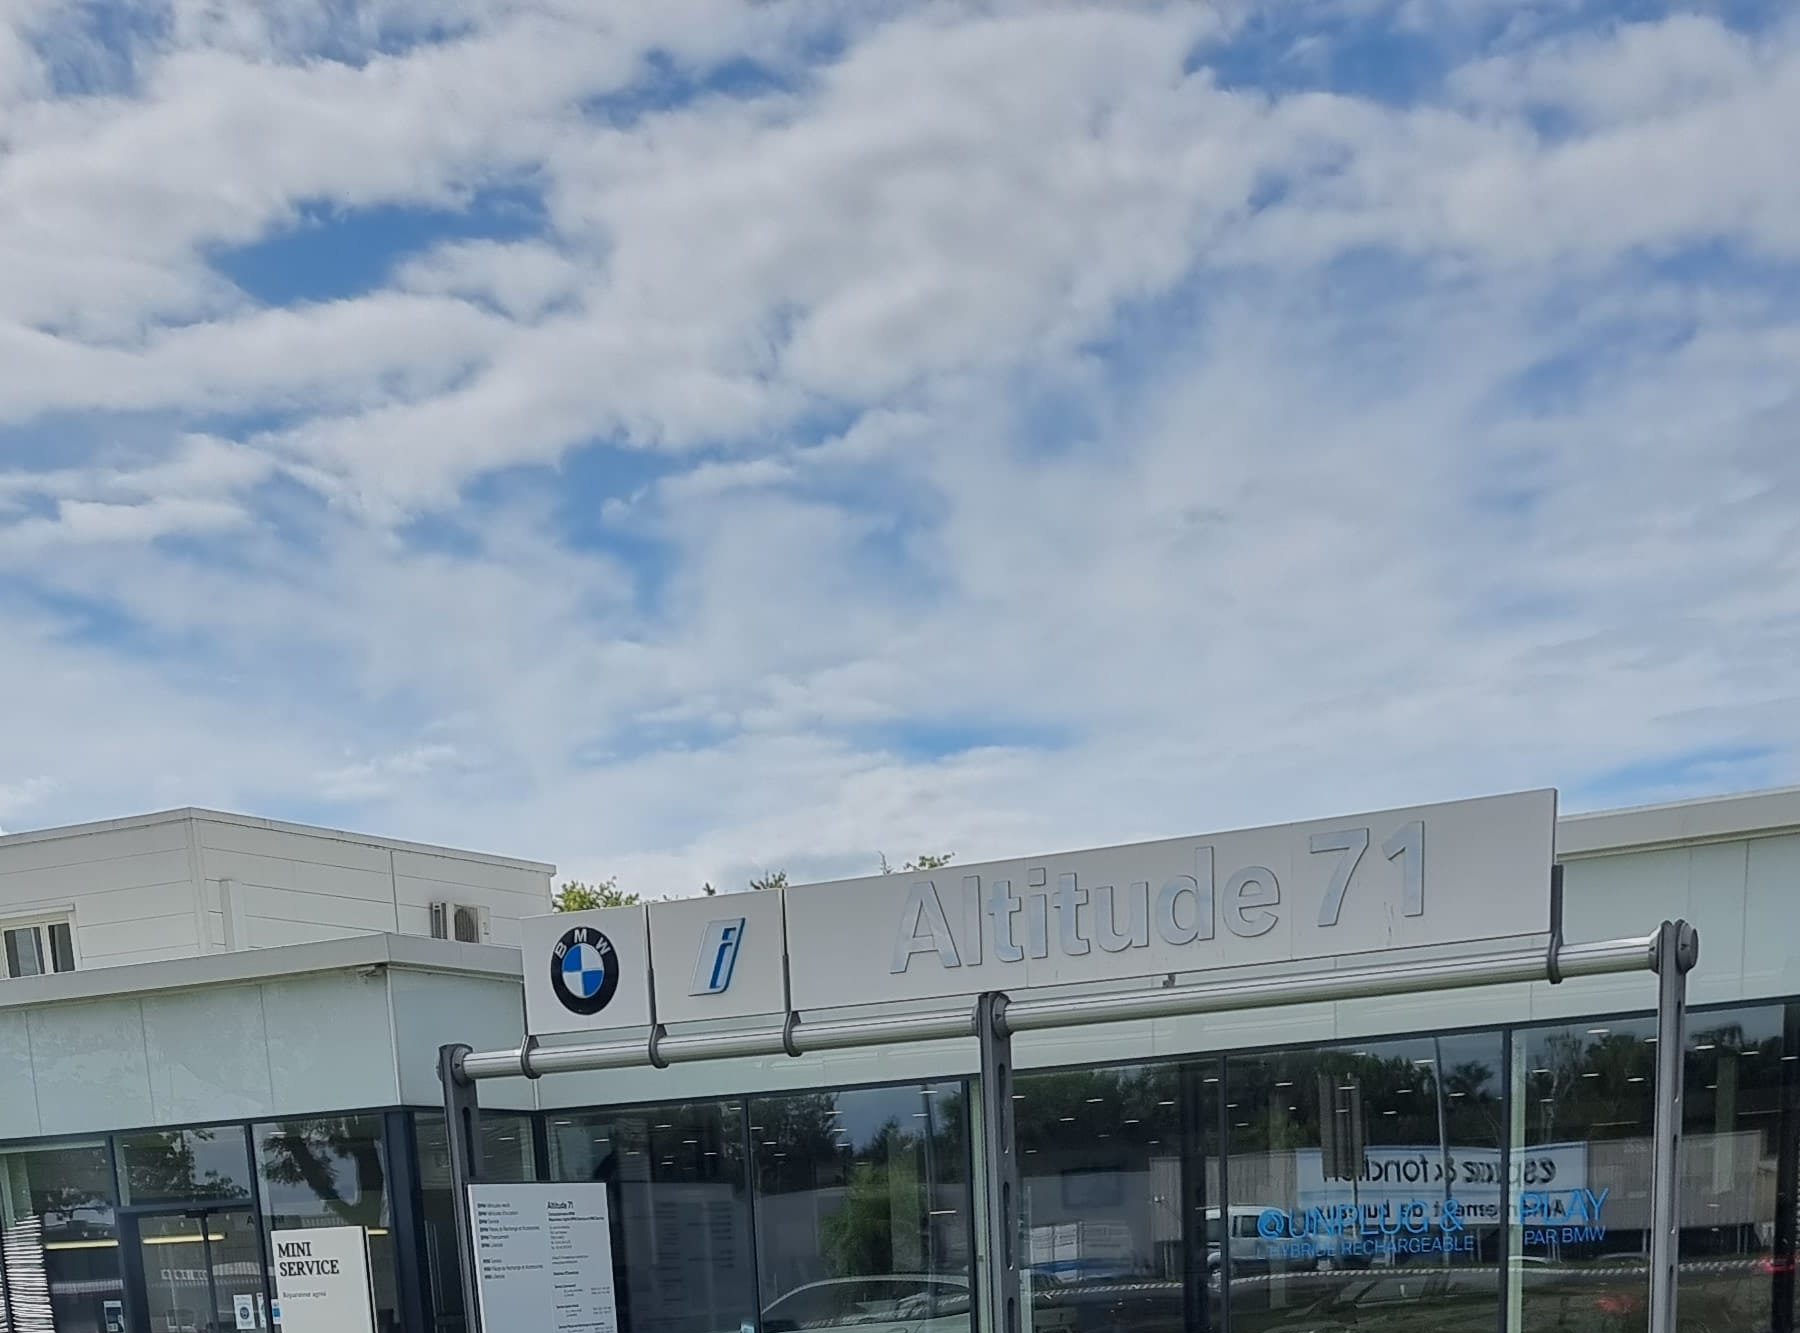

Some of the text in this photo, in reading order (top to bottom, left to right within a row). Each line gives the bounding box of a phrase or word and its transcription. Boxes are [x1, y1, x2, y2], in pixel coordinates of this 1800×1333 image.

[890, 820, 1425, 974] Altitude 71
[553, 927, 612, 960] BMW
[1439, 1199, 1464, 1232] &
[1520, 1187, 1609, 1225] PLAY
[1524, 1229, 1557, 1245] PAR
[1562, 1225, 1606, 1243] BMW
[277, 1242, 312, 1258] MINI
[280, 1260, 340, 1277] SERVICE
